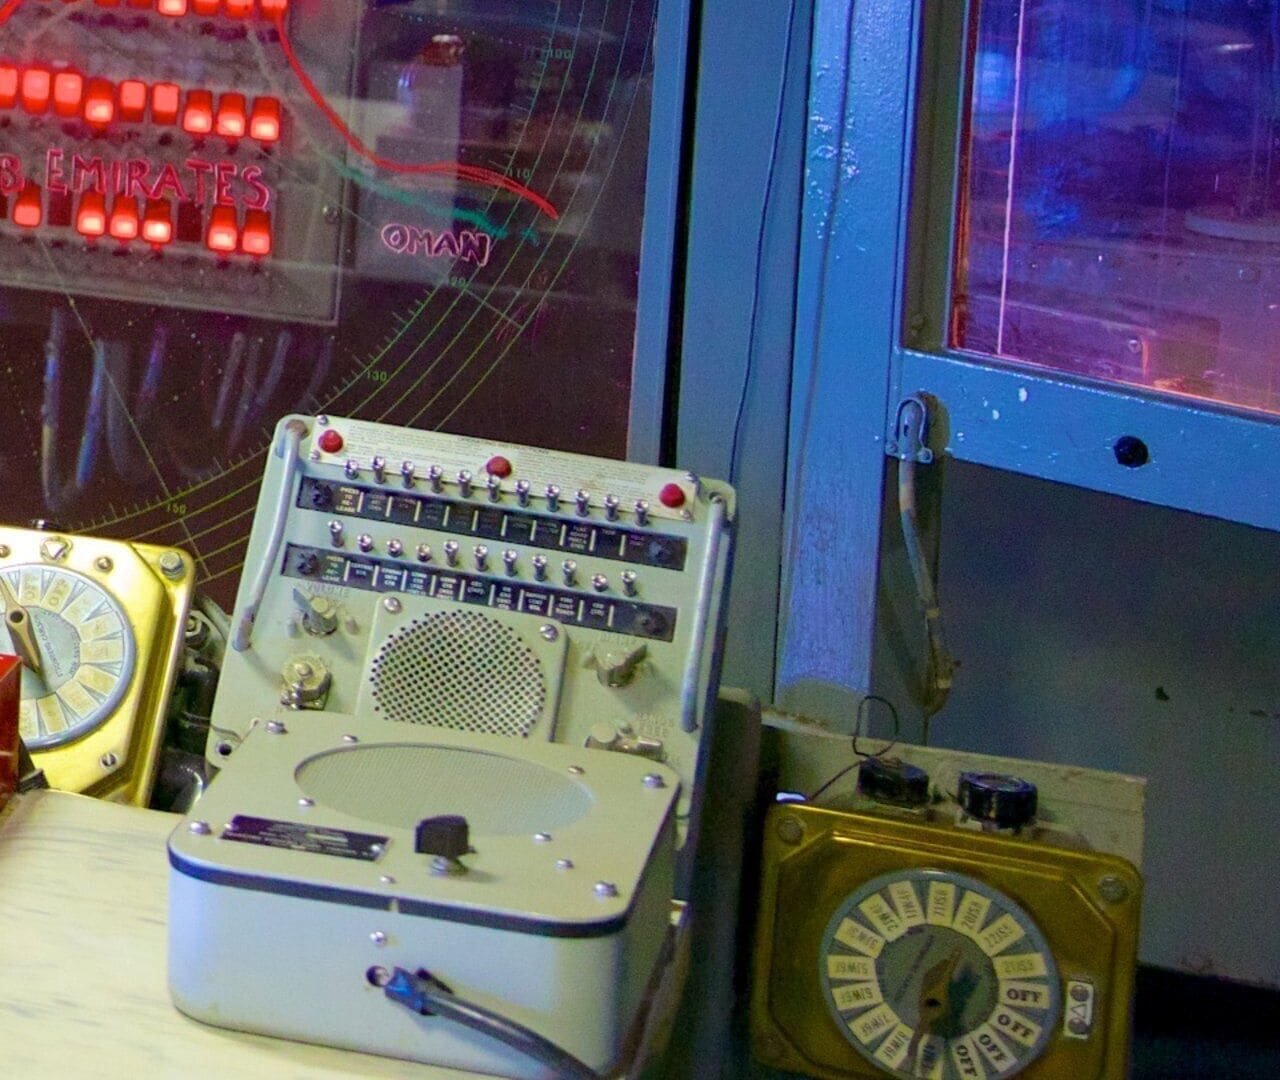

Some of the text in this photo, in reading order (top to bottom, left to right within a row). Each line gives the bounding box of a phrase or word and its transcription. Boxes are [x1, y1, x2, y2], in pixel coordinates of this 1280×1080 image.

[45, 147, 272, 211] EMIRATES
[380, 222, 492, 268] OMAN
[1006, 987, 1041, 1003] OFF
[996, 1013, 1036, 1039] OFF
[955, 1044, 980, 1079] OFF
[978, 1033, 1008, 1063] OFF
